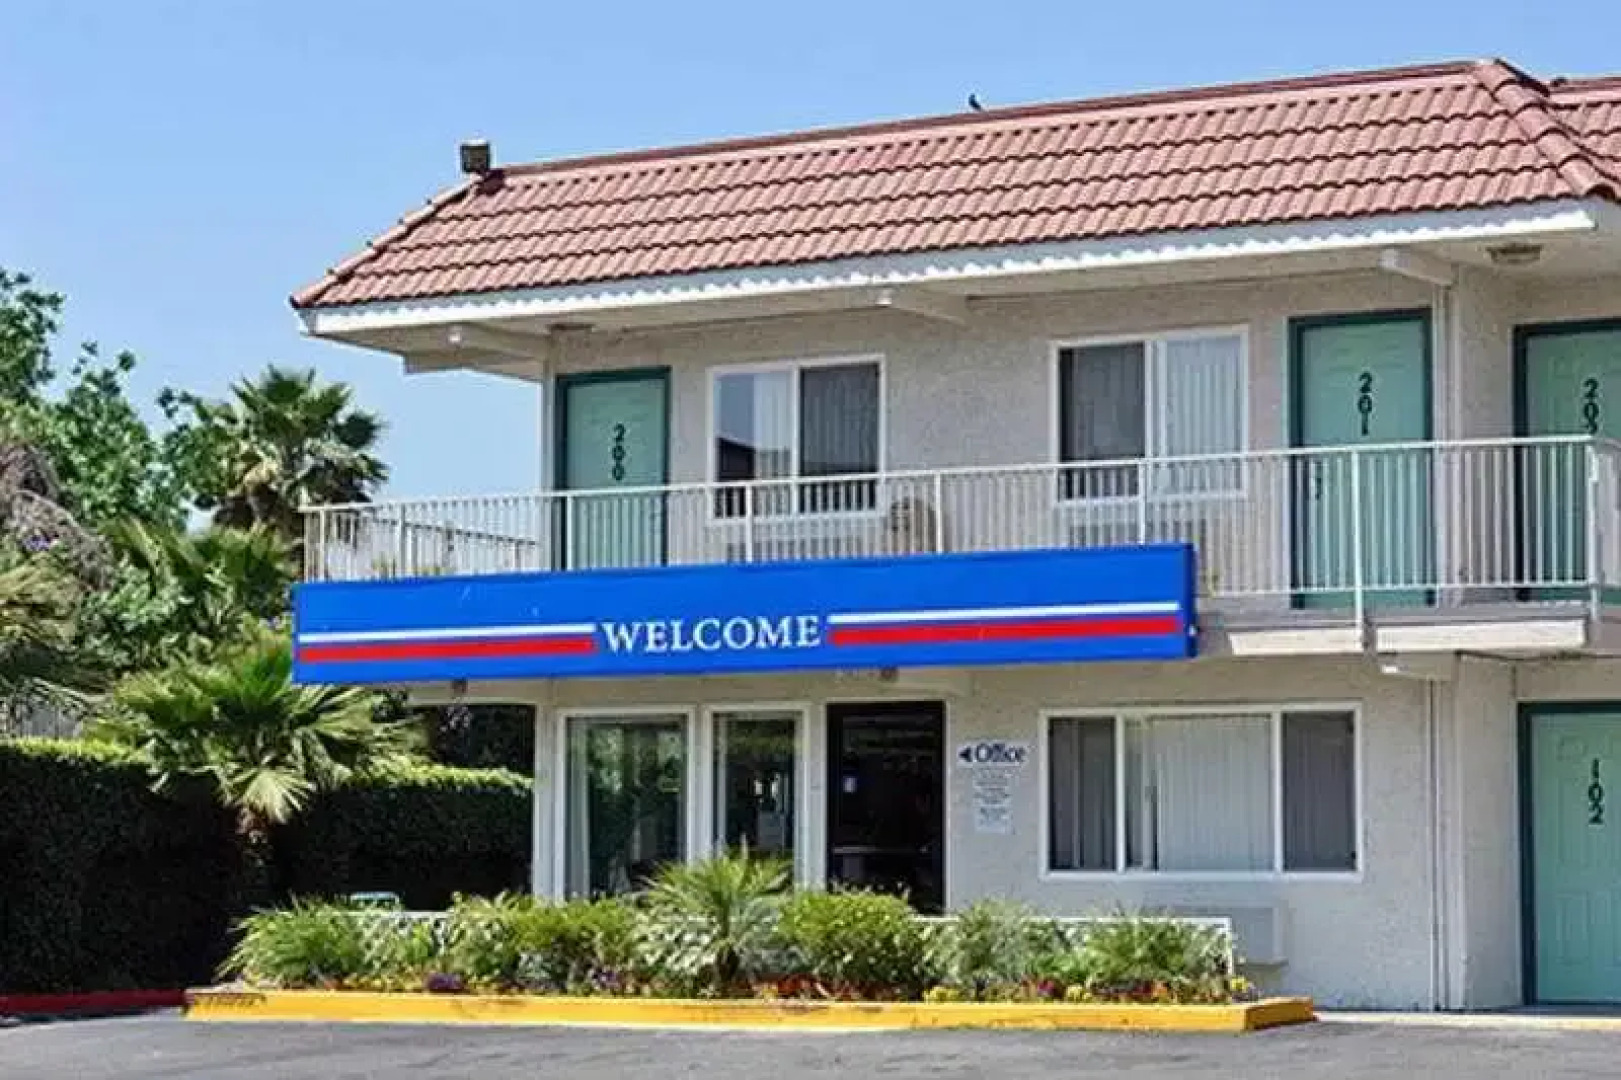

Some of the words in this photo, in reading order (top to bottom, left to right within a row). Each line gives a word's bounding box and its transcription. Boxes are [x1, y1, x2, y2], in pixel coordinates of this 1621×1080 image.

[1358, 372, 1372, 436] 201
[612, 423, 626, 481] 200
[601, 615, 821, 652] WELCOME
[976, 743, 1025, 762] Office
[1588, 758, 1603, 824] 102
